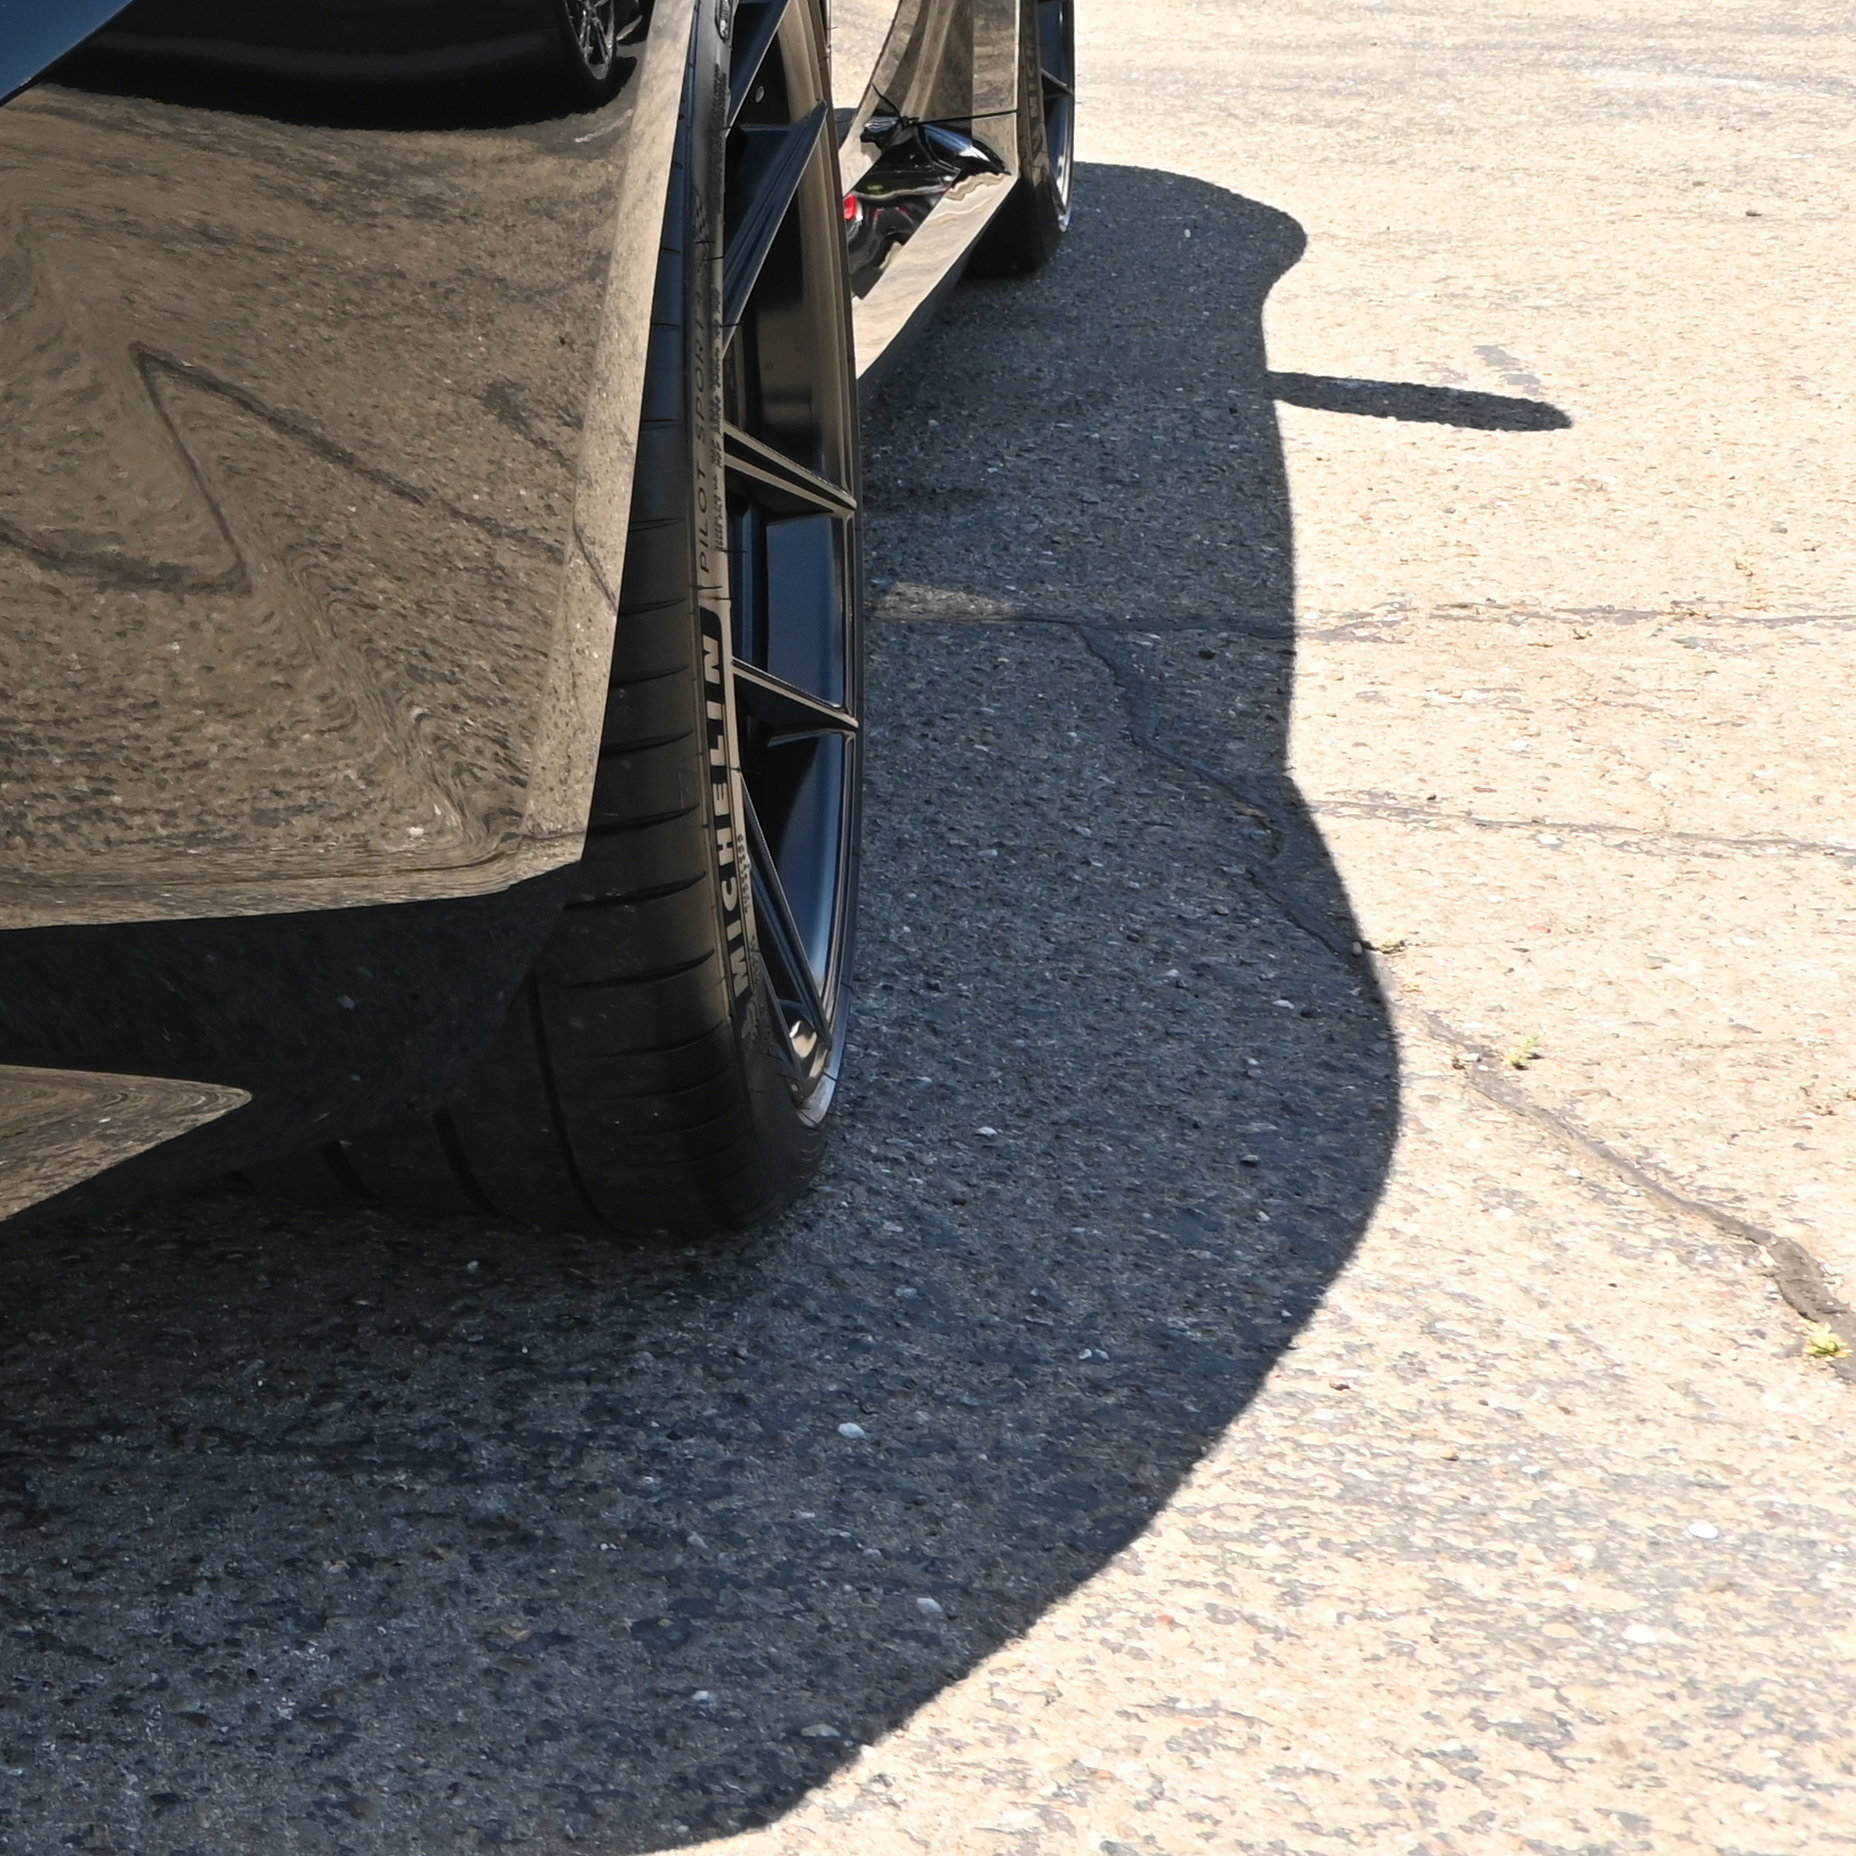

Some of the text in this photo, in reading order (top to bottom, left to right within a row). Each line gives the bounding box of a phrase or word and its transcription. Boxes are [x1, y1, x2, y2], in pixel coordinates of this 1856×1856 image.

[694, 316, 707, 444] SPORT
[696, 459, 710, 574] PILOT
[702, 633, 750, 998] MICHELIN
